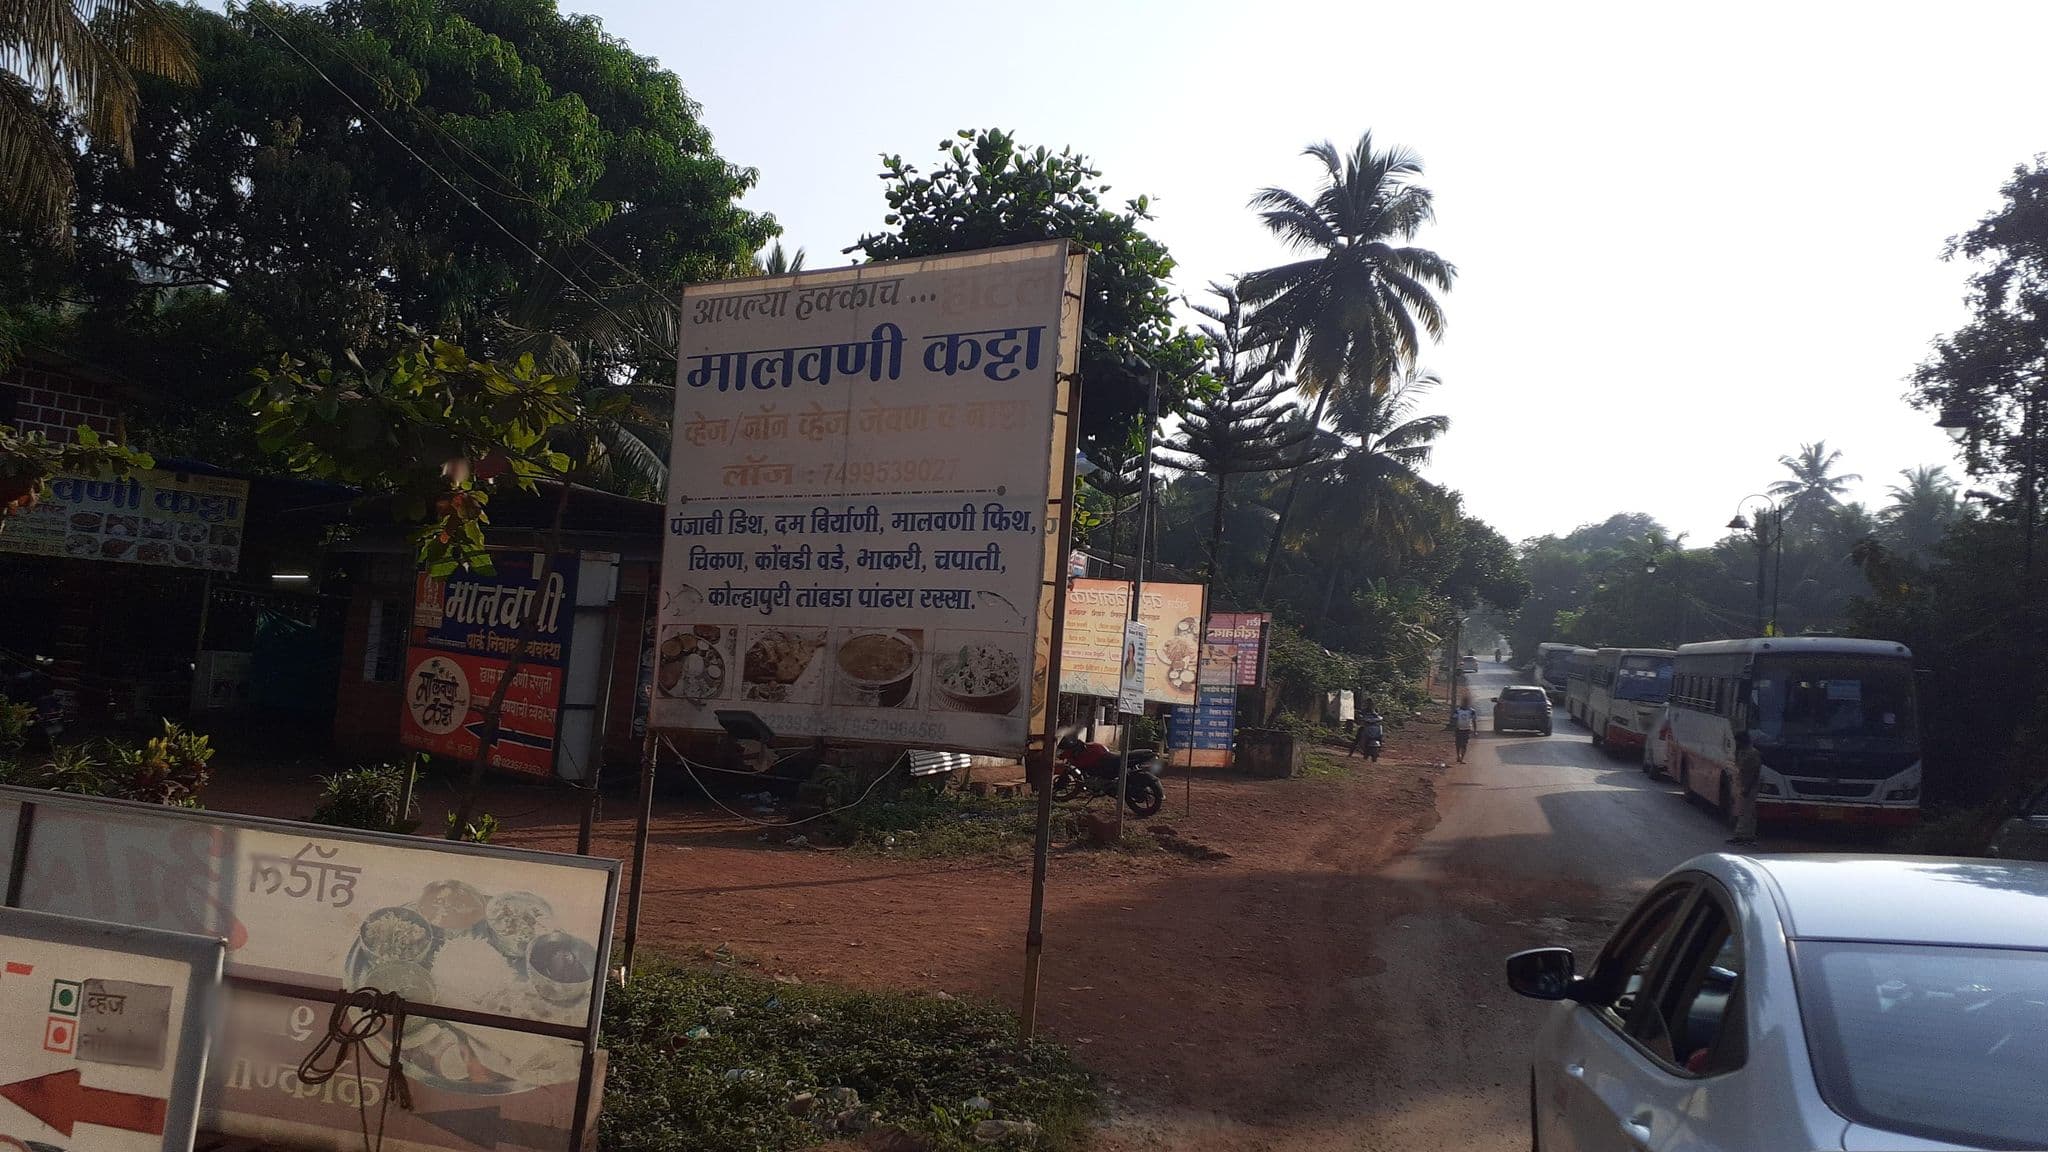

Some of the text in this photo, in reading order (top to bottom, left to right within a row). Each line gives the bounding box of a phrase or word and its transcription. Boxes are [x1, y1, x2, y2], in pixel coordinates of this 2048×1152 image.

[692, 289, 791, 326] आपल्या
[687, 321, 1046, 393] मालवणी कट्टा
[798, 402, 849, 446] व्हेज
[721, 454, 793, 487] लॉज
[670, 503, 1037, 537] पंजाबी डिश, दम बिर्याणी, मालवणी फिश,
[755, 544, 812, 572] कोंबडी
[817, 544, 849, 573] वडे,
[856, 542, 926, 573] भाकरी,
[934, 542, 1007, 573] चपाती,
[708, 582, 790, 615] कोल्हापुरी
[797, 583, 853, 609] तांबडा
